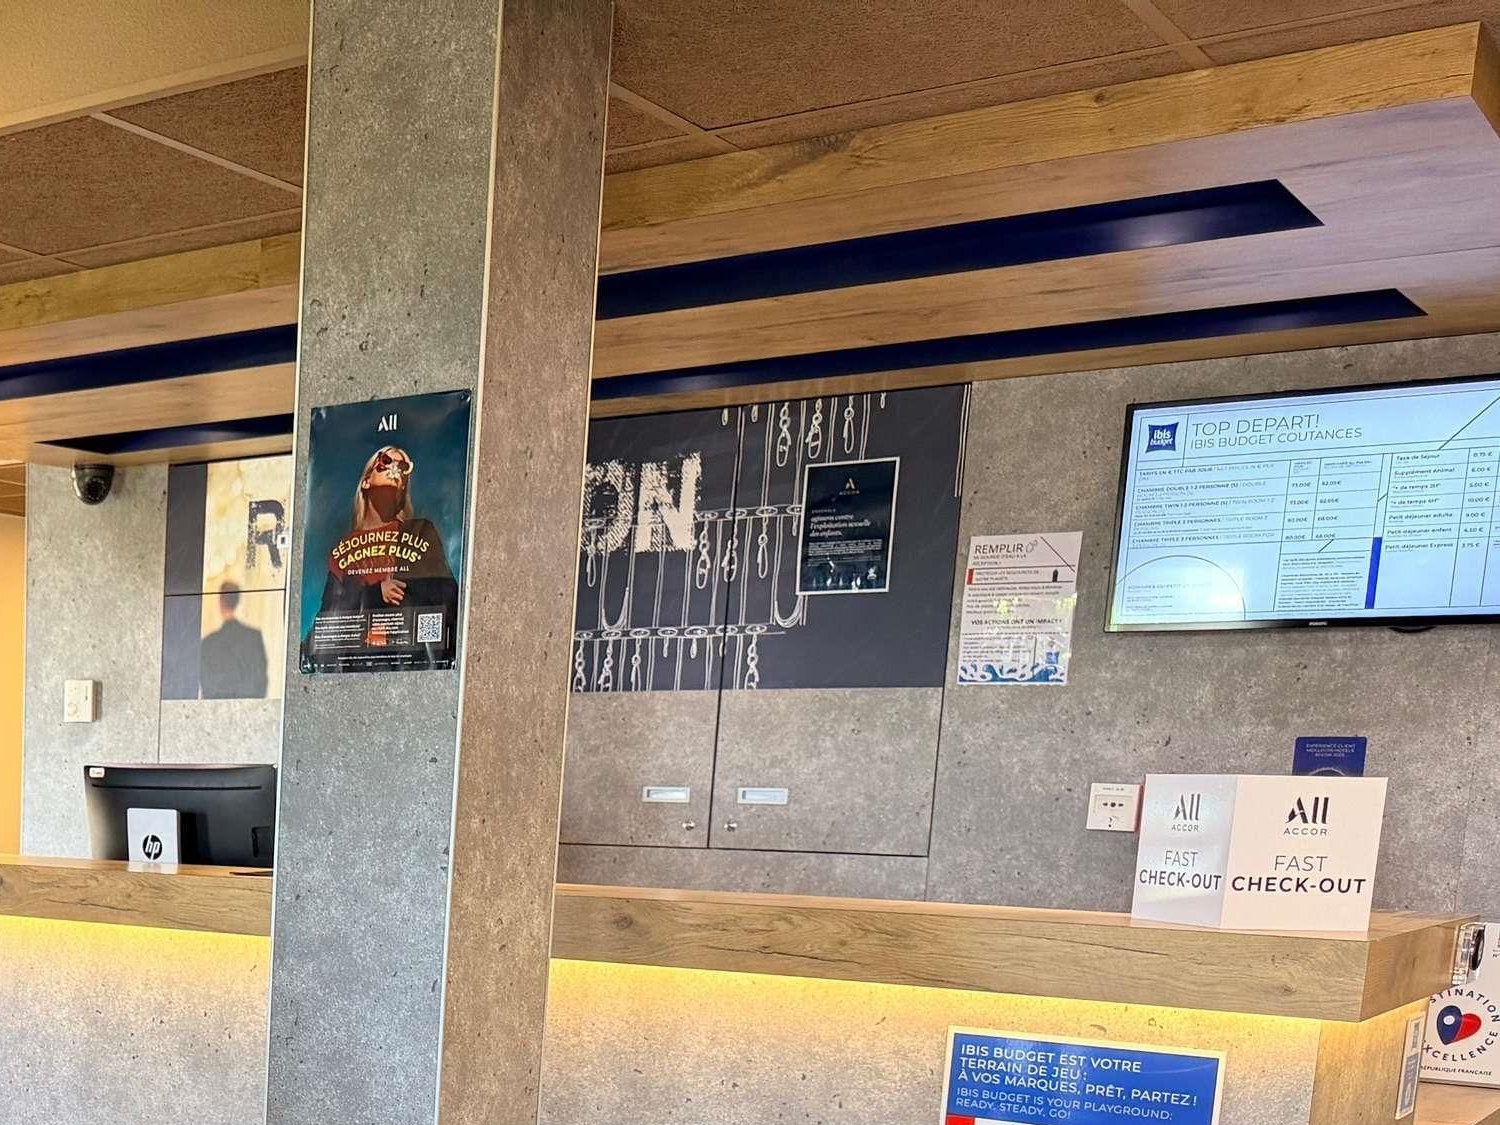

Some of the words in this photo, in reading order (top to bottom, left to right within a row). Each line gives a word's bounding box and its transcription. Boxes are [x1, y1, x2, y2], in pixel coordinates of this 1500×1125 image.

[378, 414, 397, 432] All
[1153, 428, 1172, 440] ibis
[1192, 420, 1230, 437] TOP
[1237, 414, 1319, 433] DEPART!
[1191, 436, 1214, 449] IBIS
[1219, 433, 1273, 447] BUDGET
[1278, 427, 1362, 443] COUTANCES
[246, 500, 284, 569] R
[332, 531, 399, 559] SÉJOURNEZ
[401, 532, 430, 552] PLUS
[338, 545, 386, 570] GAGNEZ
[975, 543, 1023, 554] REMPLIR
[1174, 793, 1200, 821] All
[1285, 797, 1329, 825] All
[1171, 824, 1199, 832] ACCOR
[1283, 827, 1328, 836] ACCOR
[143, 834, 162, 860] hp
[1164, 850, 1198, 868] FAST
[1274, 855, 1328, 872] FAST
[1139, 869, 1222, 891] CHECK-OUT
[1231, 876, 1366, 895] CHECK-OUT
[1429, 988, 1500, 1023] STINATION
[960, 1057, 1021, 1073] TERRAIN
[1027, 1064, 1047, 1077] DE
[961, 1044, 989, 1057] IBIS
[993, 1047, 1055, 1064] BUDGET
[1060, 1054, 1086, 1066] EST
[1091, 1057, 1142, 1073] VOTRE
[958, 1068, 968, 1081] À
[972, 1072, 1000, 1084] VOS
[1004, 1076, 1081, 1095] MARQUES,
[1086, 1084, 1126, 1100] PRÊT,
[957, 1087, 979, 1098] IBIS
[982, 1090, 1030, 1103] BUDGET
[1033, 1096, 1044, 1105] IS
[1046, 1098, 1080, 1109] YOUR
[1084, 1101, 1173, 1121] PLAYGROUND:
[1000, 1102, 1046, 1117] STEADY,
[1049, 1109, 1071, 1119] GO!
